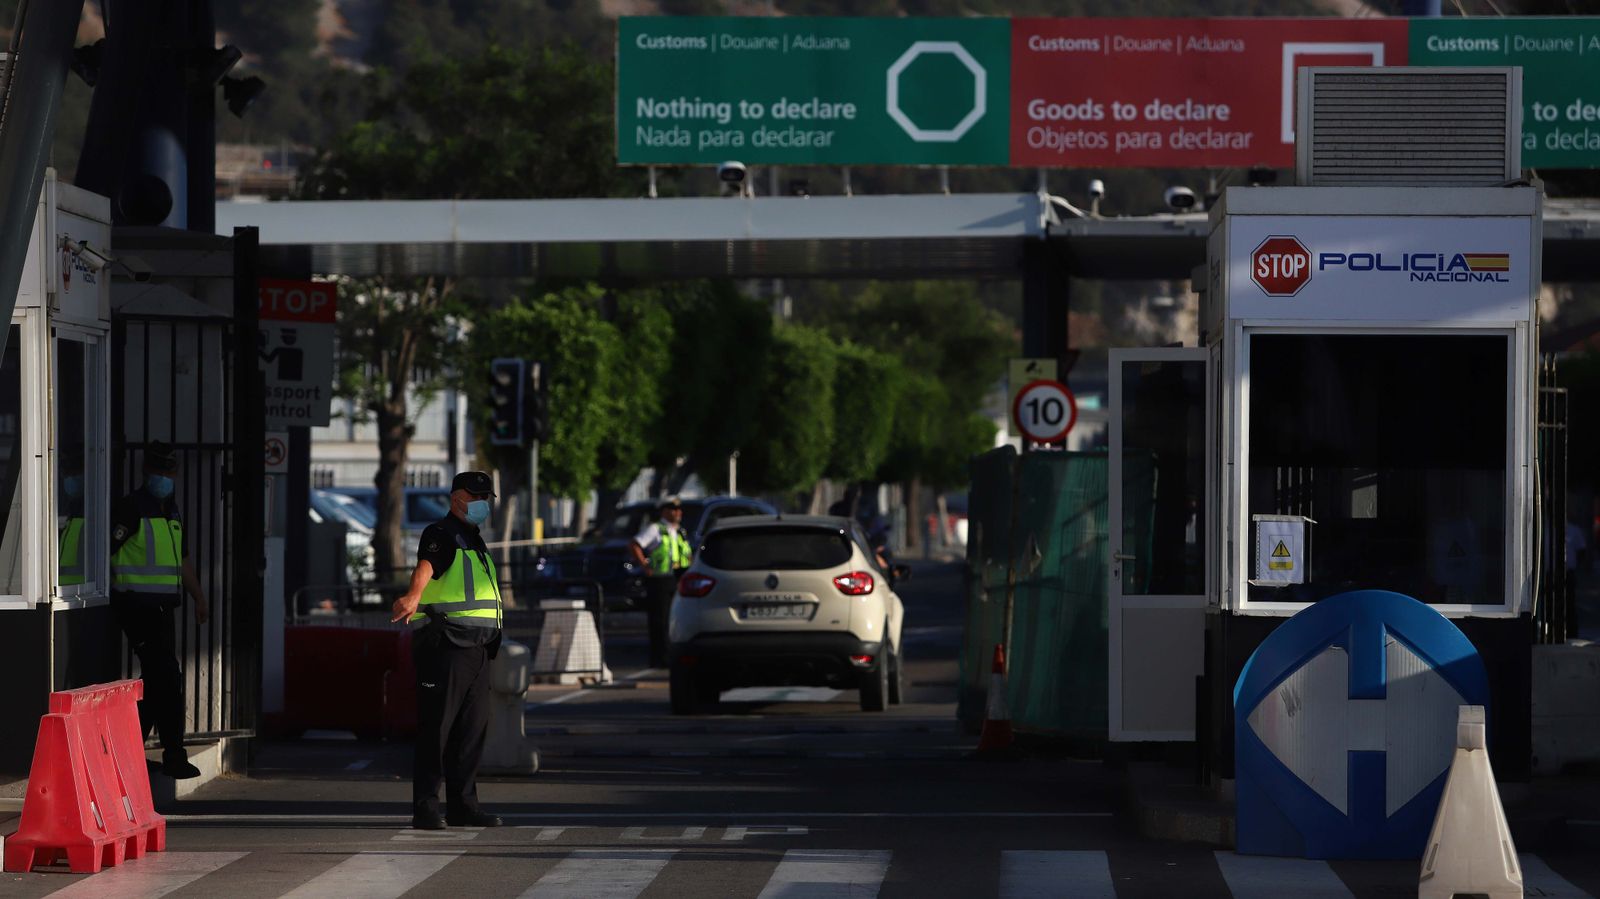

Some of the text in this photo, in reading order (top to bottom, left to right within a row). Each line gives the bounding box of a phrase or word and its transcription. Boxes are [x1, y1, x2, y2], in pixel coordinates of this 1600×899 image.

[636, 33, 850, 50] Customs Douane Aduana
[1028, 35, 1244, 52] Customs Douane Aduana
[1427, 35, 1500, 52] Customs
[1513, 35, 1574, 51] Douane
[636, 97, 857, 124] Nothing to declare
[1027, 98, 1230, 121] Goods to declare
[1532, 100, 1559, 121] to
[636, 125, 835, 152] Nada para declarar
[1027, 126, 1253, 153] Objetos para declarar
[1256, 253, 1306, 279] STOP
[1410, 272, 1509, 282] NACIONAL
[1026, 398, 1063, 425] 10
